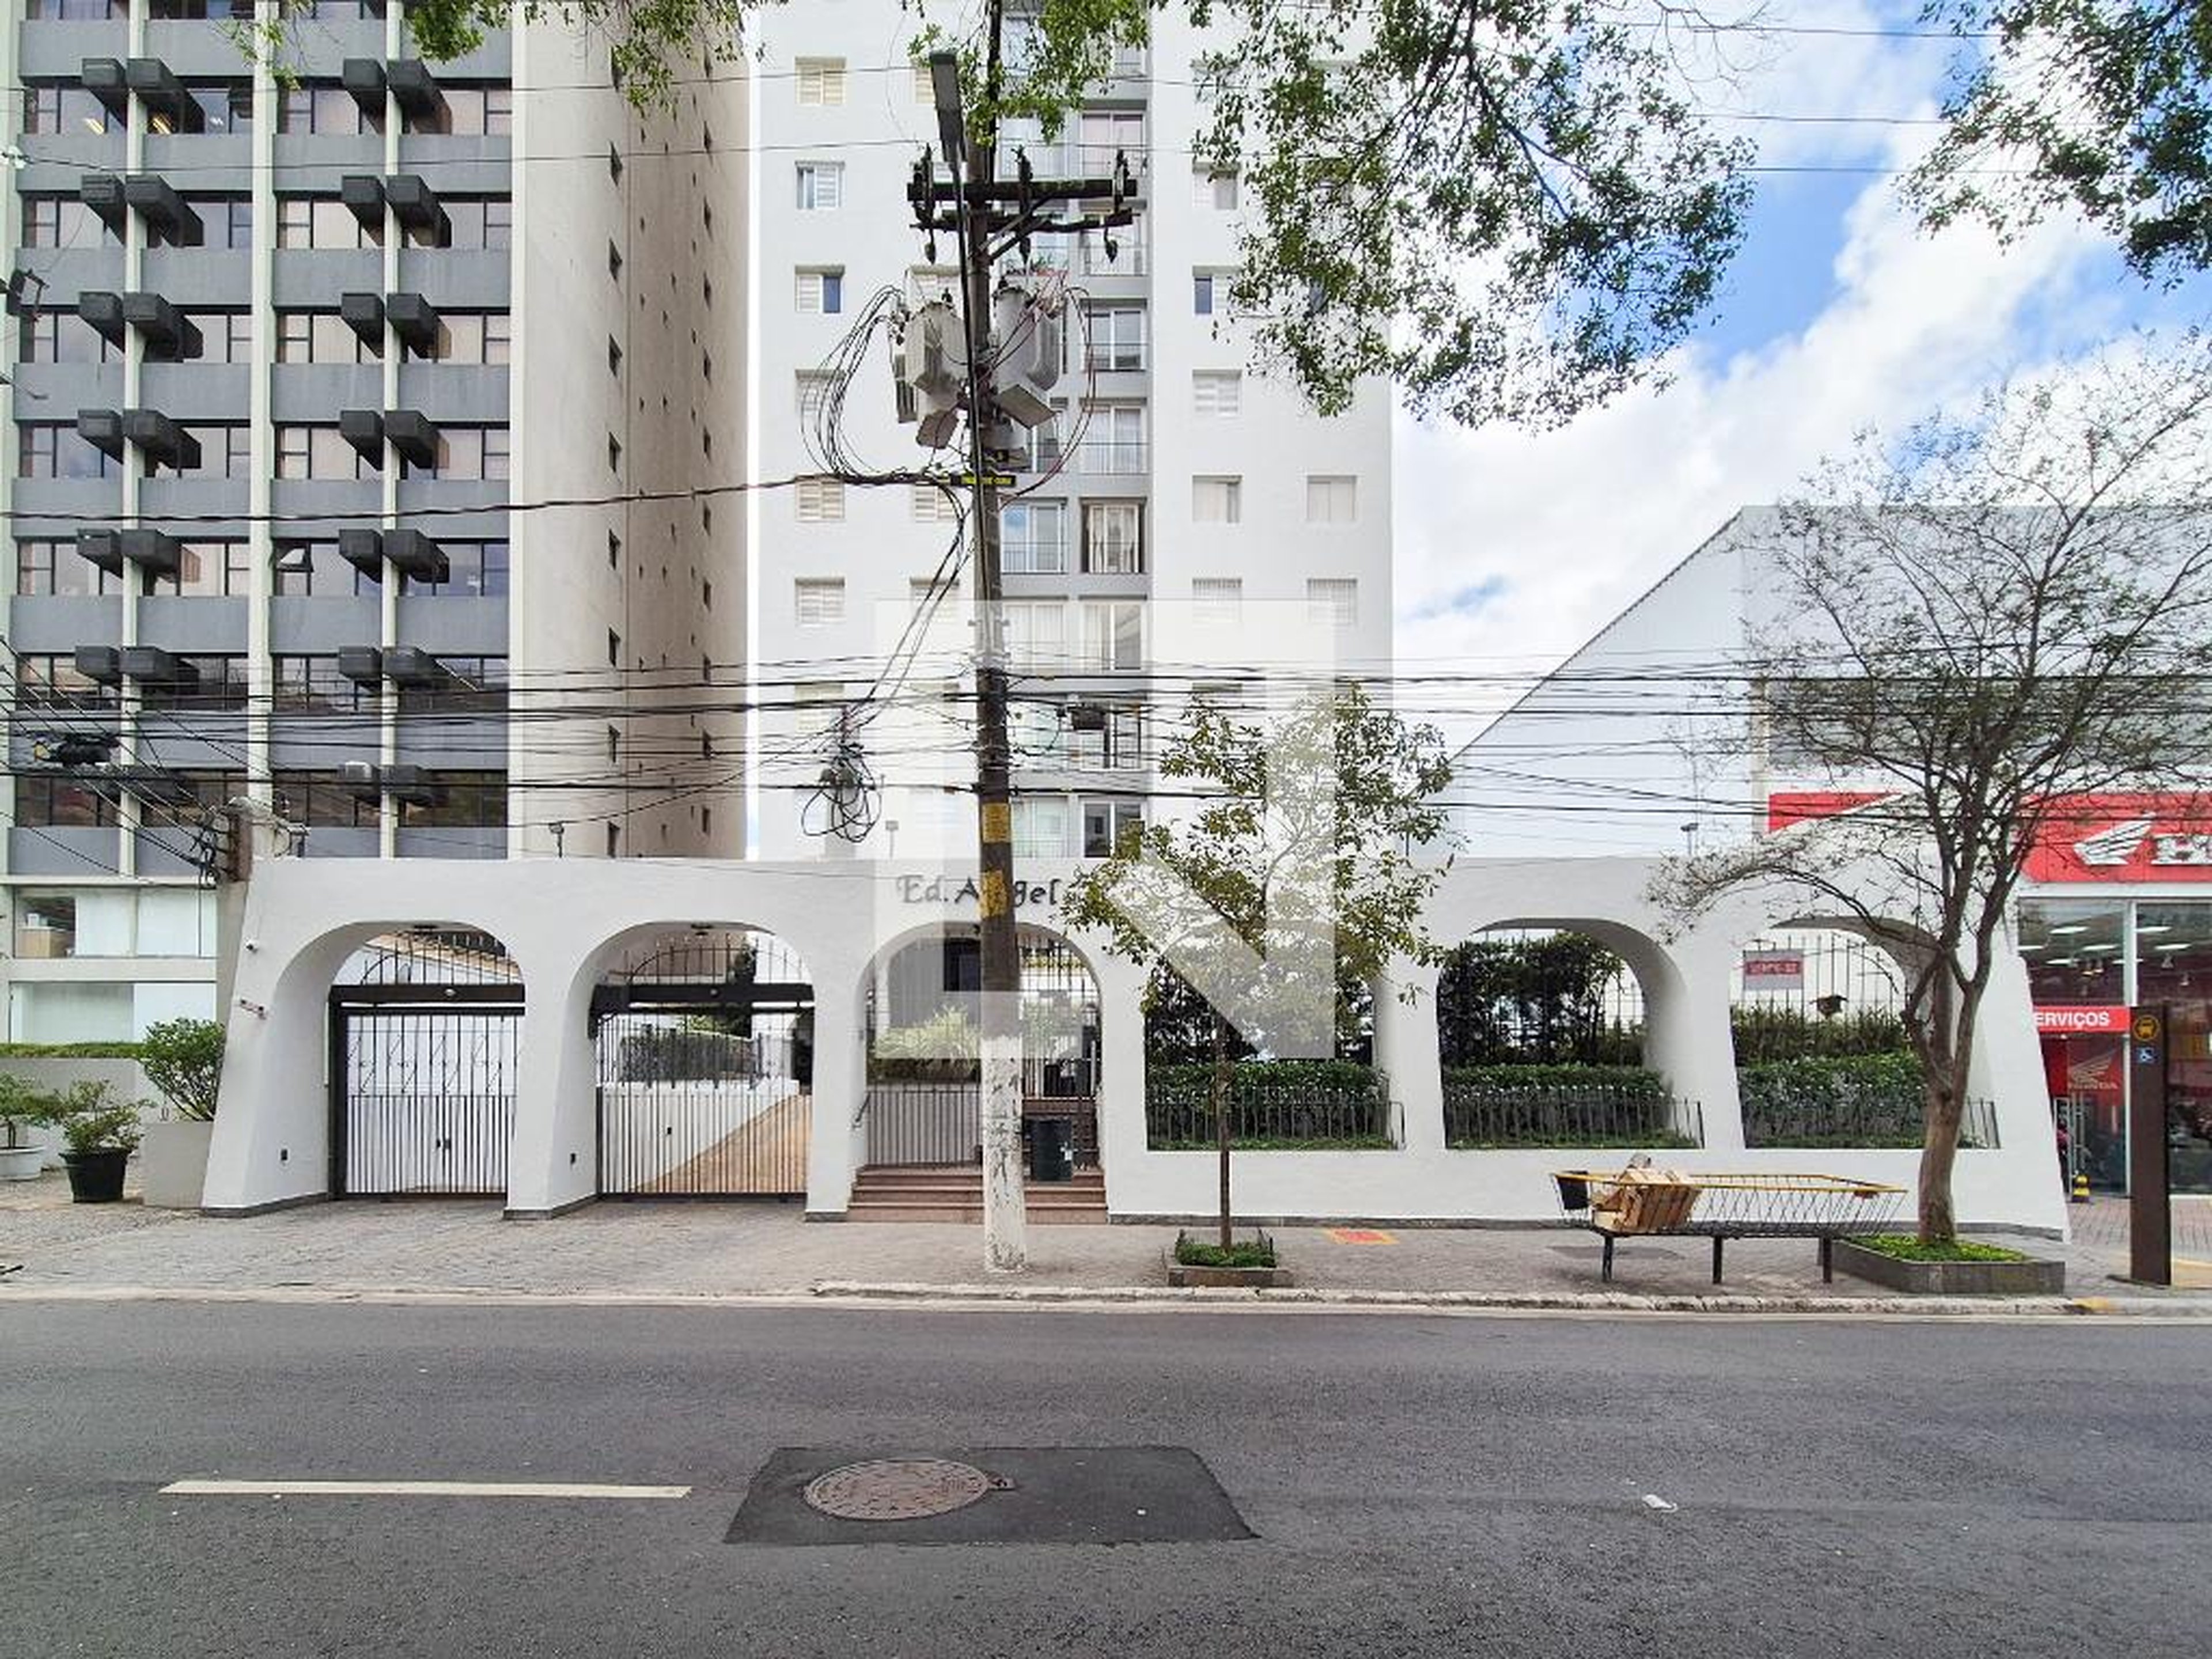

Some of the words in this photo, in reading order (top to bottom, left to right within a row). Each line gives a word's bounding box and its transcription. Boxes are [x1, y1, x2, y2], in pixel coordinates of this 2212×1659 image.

[896, 874, 949, 903] Ed.
[954, 876, 1063, 908] Agel
[2034, 1011, 2111, 1030] ERVIÇOS
